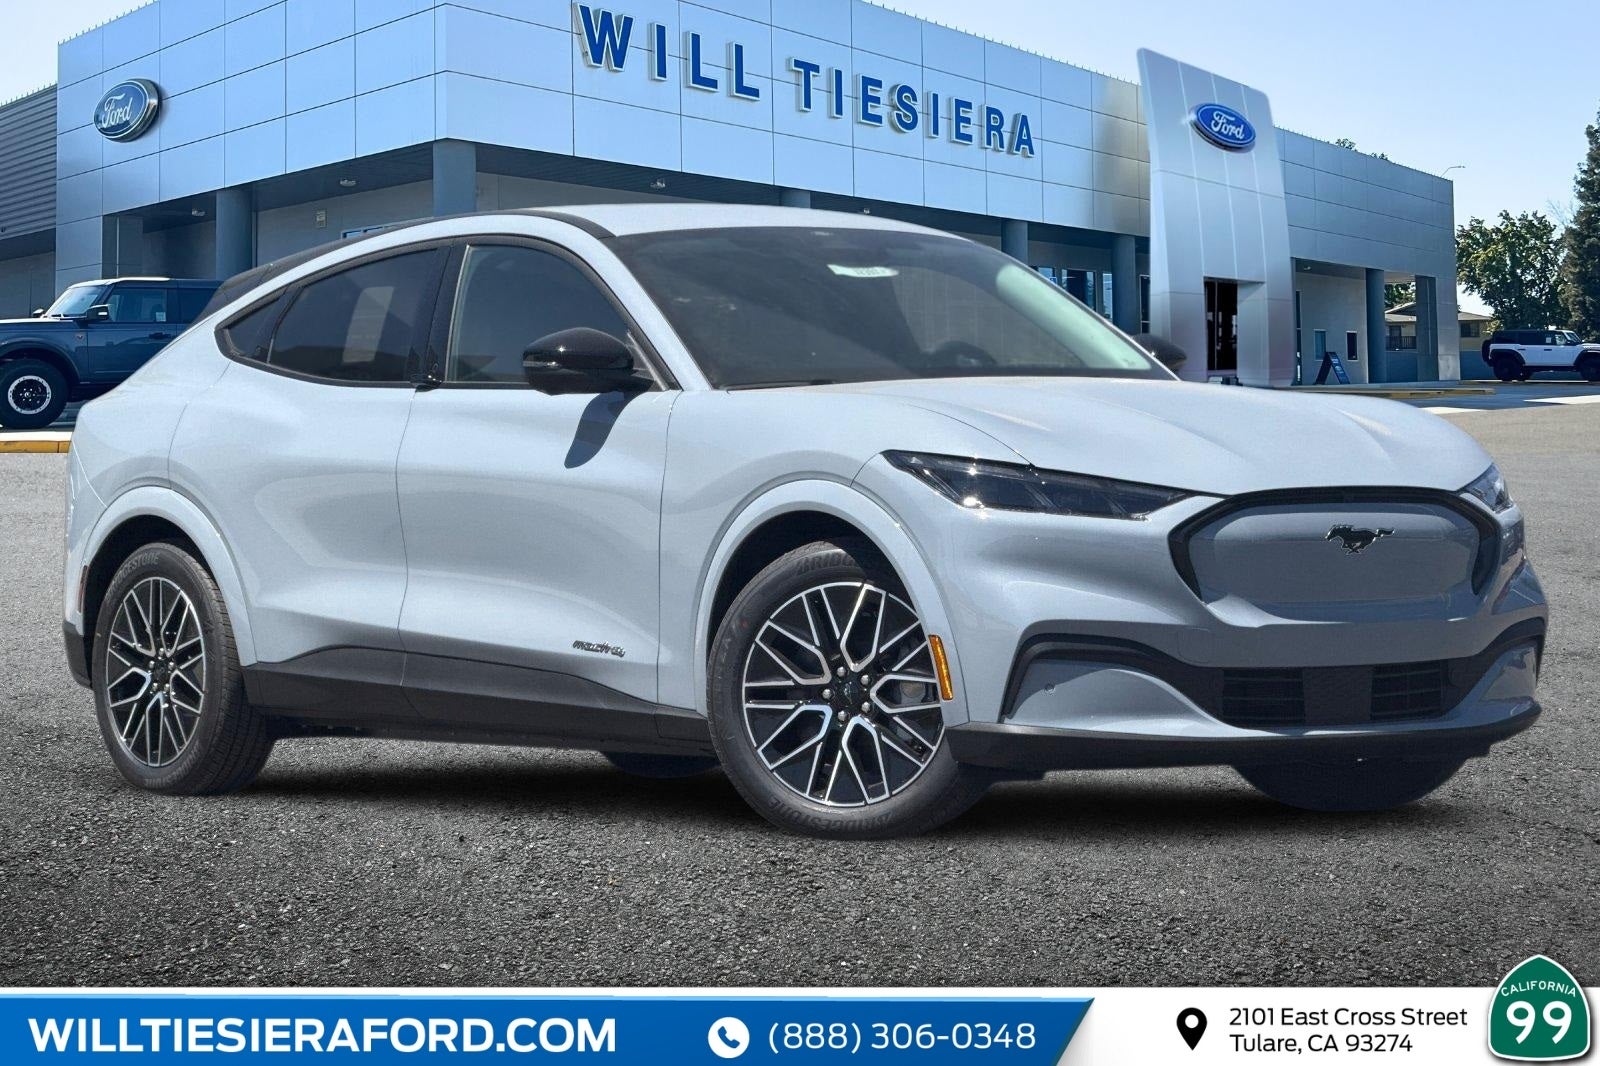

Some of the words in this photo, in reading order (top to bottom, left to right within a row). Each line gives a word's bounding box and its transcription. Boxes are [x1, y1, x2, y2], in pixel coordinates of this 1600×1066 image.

[574, 3, 760, 101] WILL
[789, 57, 1035, 157] TIESIERA
[101, 93, 133, 128] Ford
[1210, 110, 1245, 140] Ford
